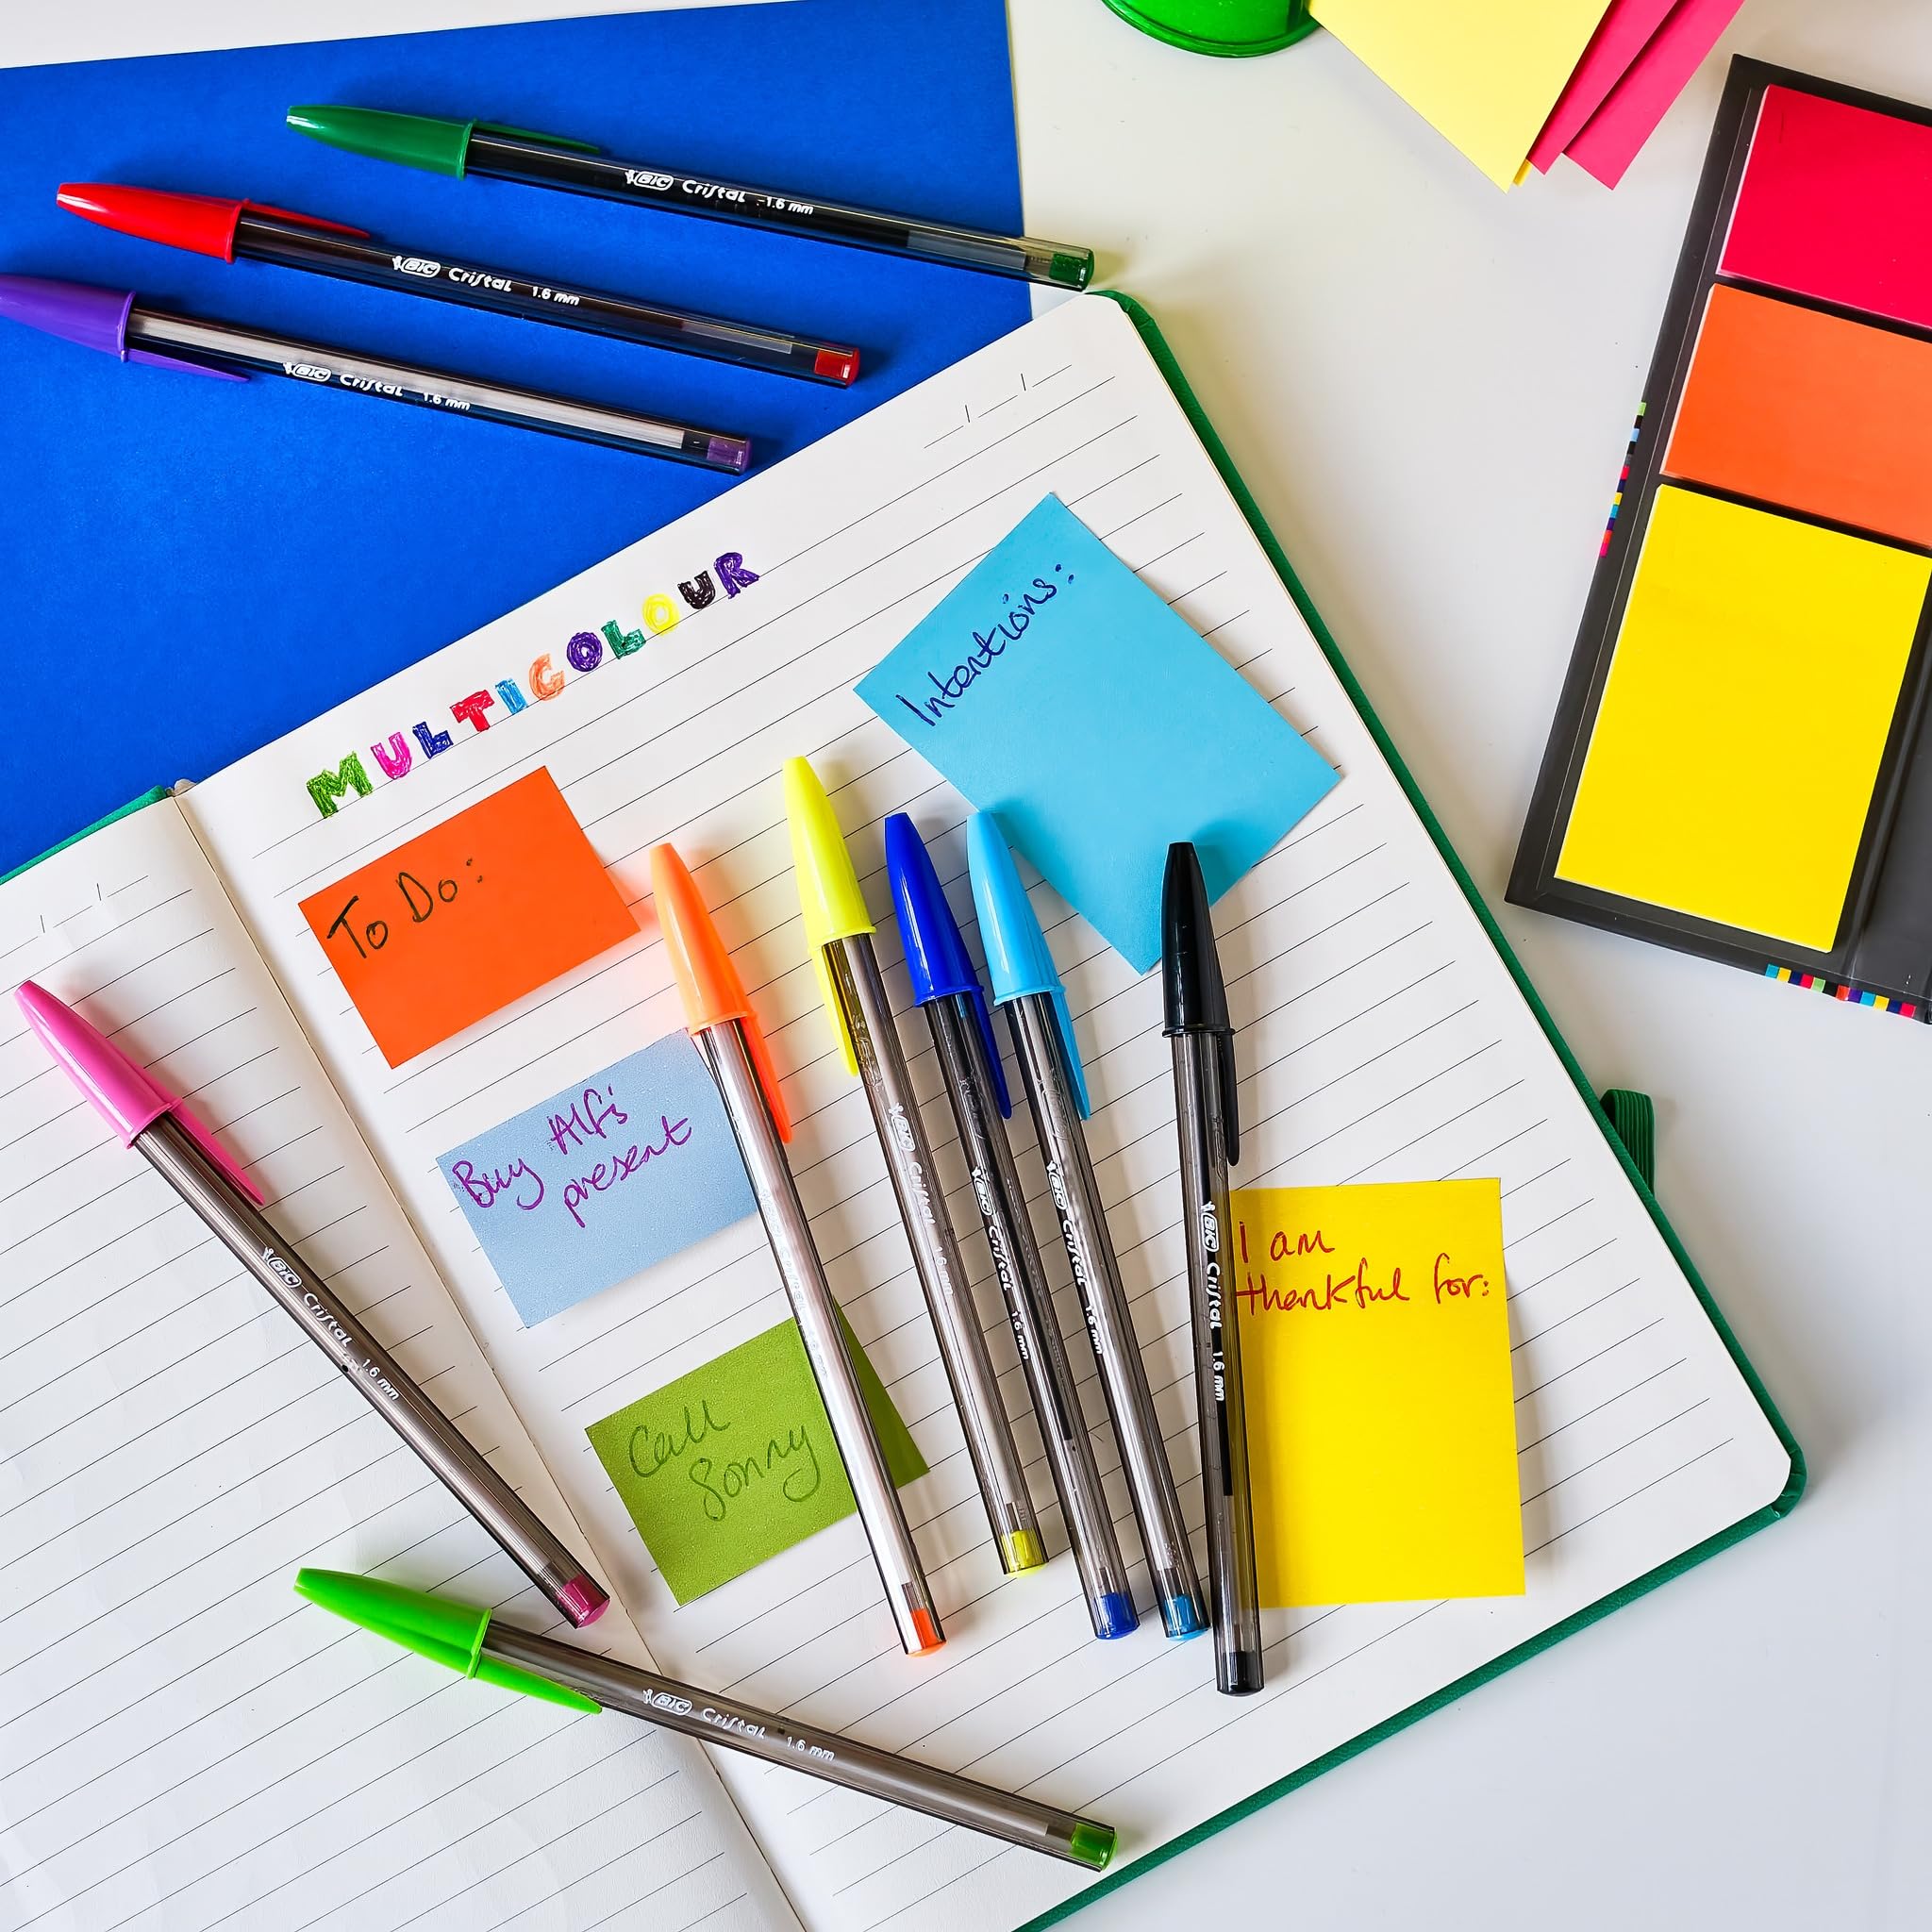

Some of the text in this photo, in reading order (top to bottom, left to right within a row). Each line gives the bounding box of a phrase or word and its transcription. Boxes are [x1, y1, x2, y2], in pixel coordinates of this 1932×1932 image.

[682, 179, 746, 203] Cristal
[788, 201, 814, 215] mm
[448, 267, 512, 291] Cristal
[532, 286, 551, 299] 1.6
[554, 291, 580, 306] mm
[340, 374, 403, 396] Cristal
[424, 391, 441, 405] 1.6
[445, 397, 471, 411] mm
[895, 563, 1074, 727] Intentions:
[306, 552, 760, 819] MULTICOLOUR
[326, 895, 389, 958] To
[452, 1159, 544, 1210] Buy
[563, 1115, 692, 1228] present
[1239, 1221, 1336, 1264] I am
[989, 1226, 1012, 1291] Cristal
[1018, 1335, 1028, 1360] mm
[1063, 1219, 1087, 1286] Cristal
[1091, 1328, 1103, 1355] mm
[1207, 1262, 1223, 1329] Cristal
[1236, 1252, 1490, 1316] thankful for:
[304, 1292, 353, 1347] Cristal
[362, 1358, 380, 1377] 1.6
[377, 1378, 400, 1401] mm
[1212, 1351, 1225, 1372] 1.6
[1214, 1374, 1224, 1402] mm
[628, 1400, 731, 1478] Call
[689, 1424, 822, 1522] Sonny
[701, 1707, 766, 1739] Cristal
[787, 1736, 806, 1752] 1.6
[808, 1745, 836, 1762] mm
